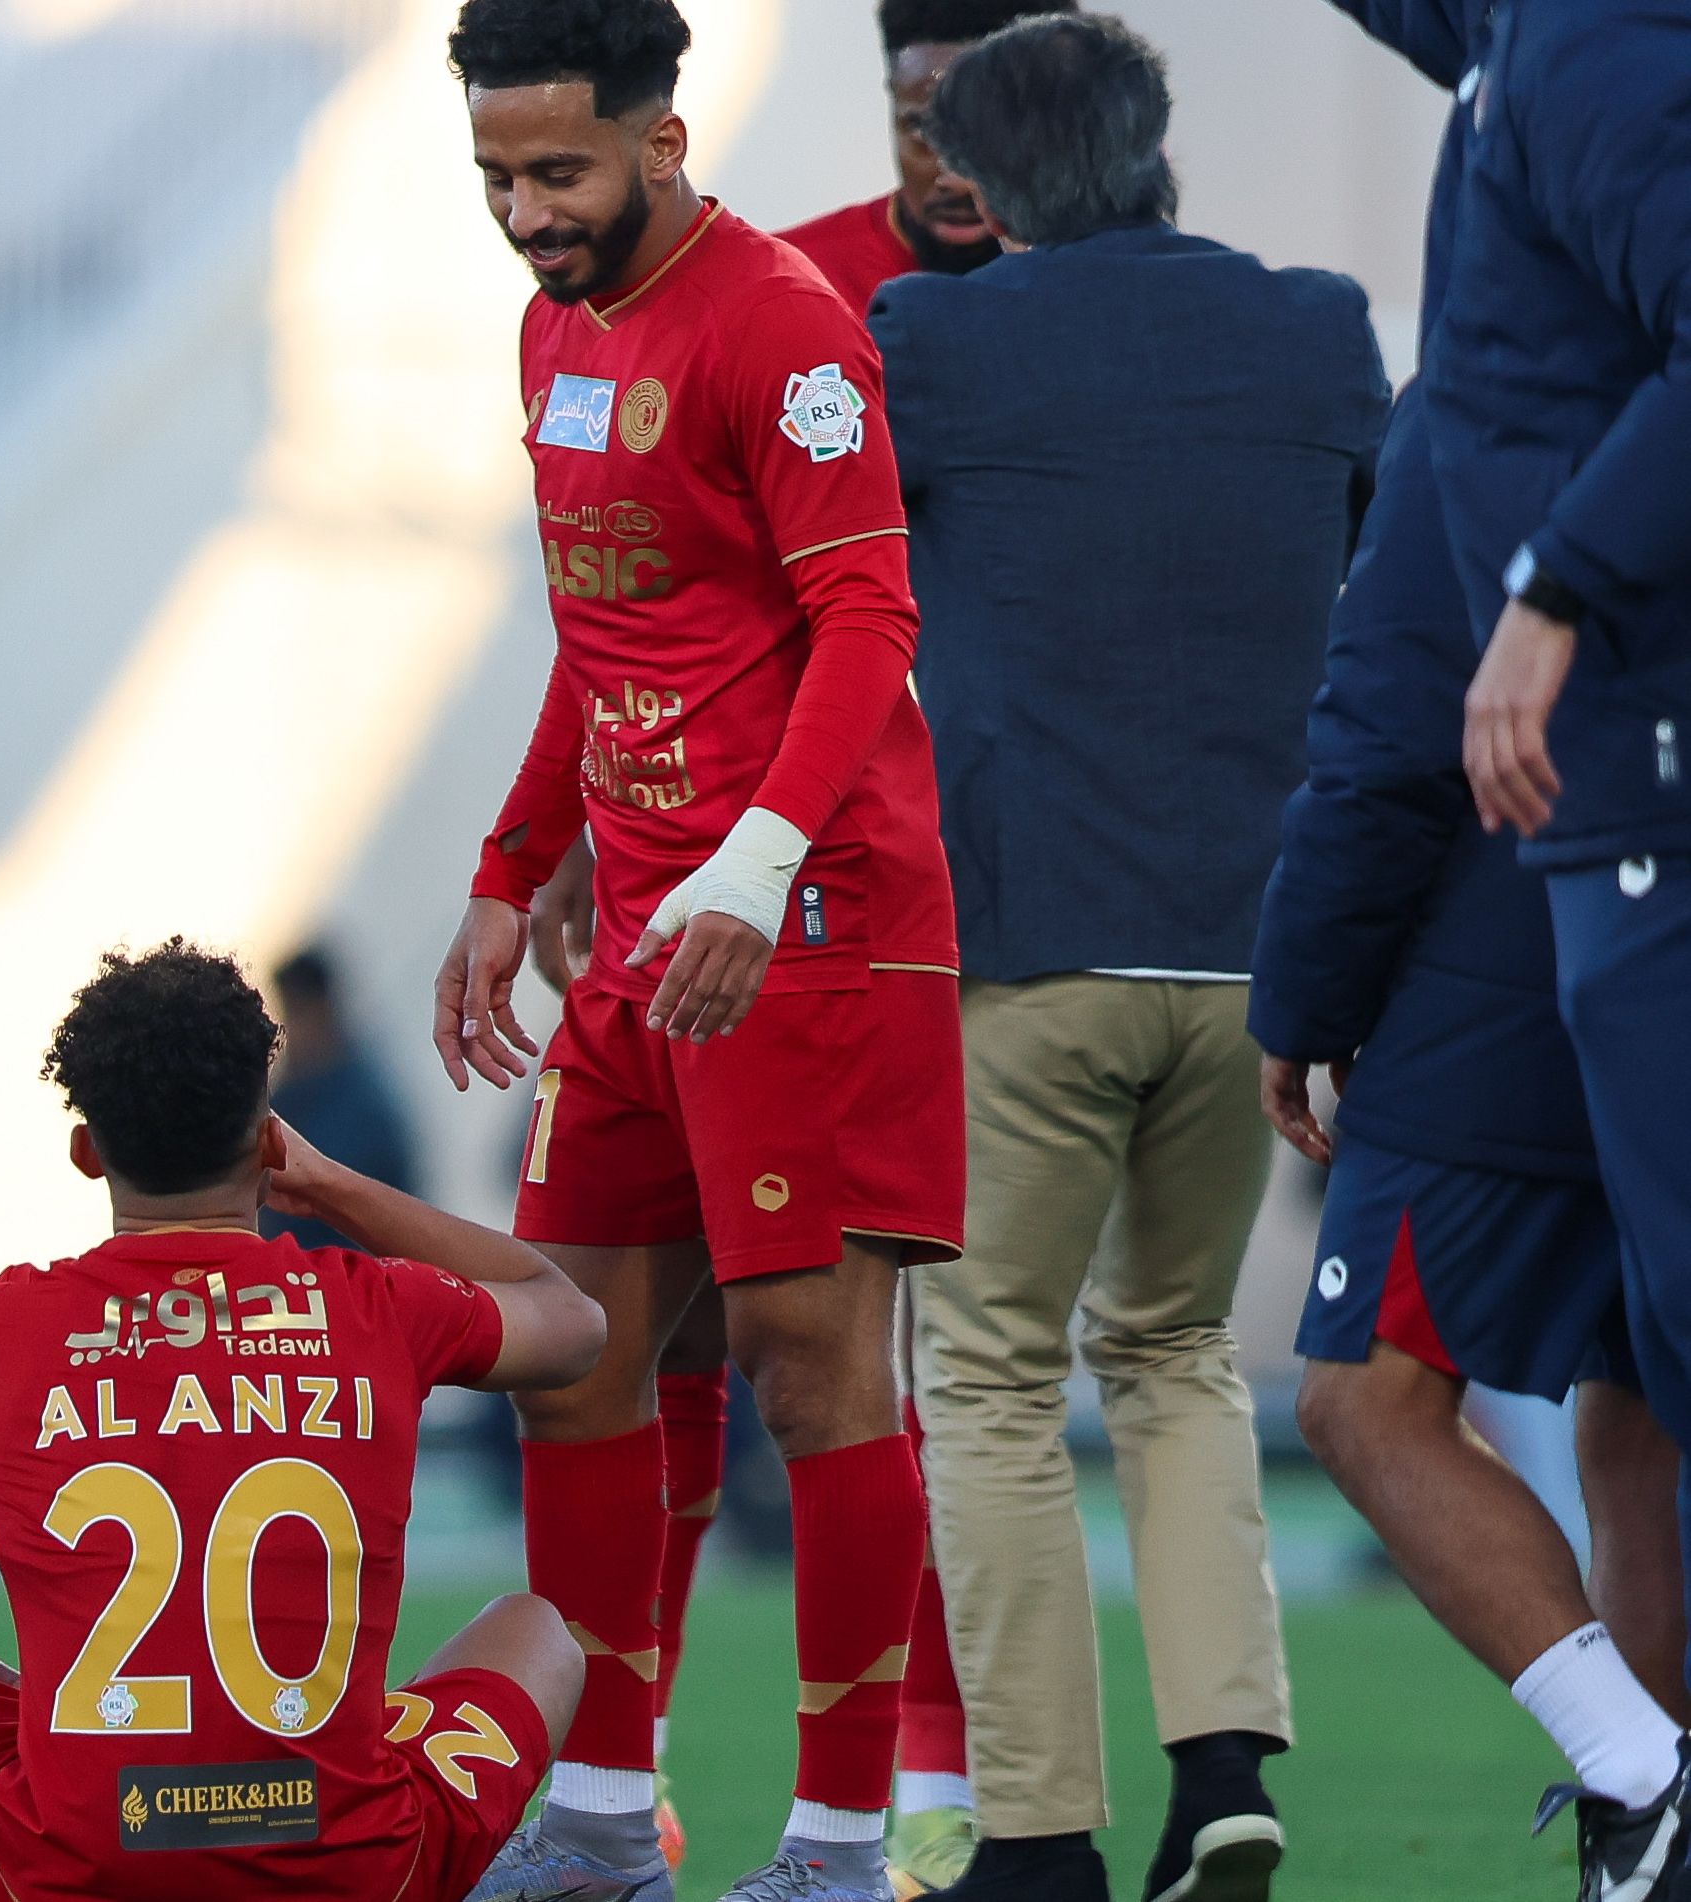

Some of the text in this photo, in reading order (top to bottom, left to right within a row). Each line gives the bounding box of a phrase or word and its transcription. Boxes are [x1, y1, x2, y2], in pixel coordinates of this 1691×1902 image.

[810, 401, 844, 422] RSL
[613, 512, 653, 532] AS
[217, 1333, 332, 1357] Tadawi
[35, 1374, 374, 1449] AL ANZI
[42, 1456, 364, 1738] 20
[155, 1779, 315, 1815] CHEEK&RIB
